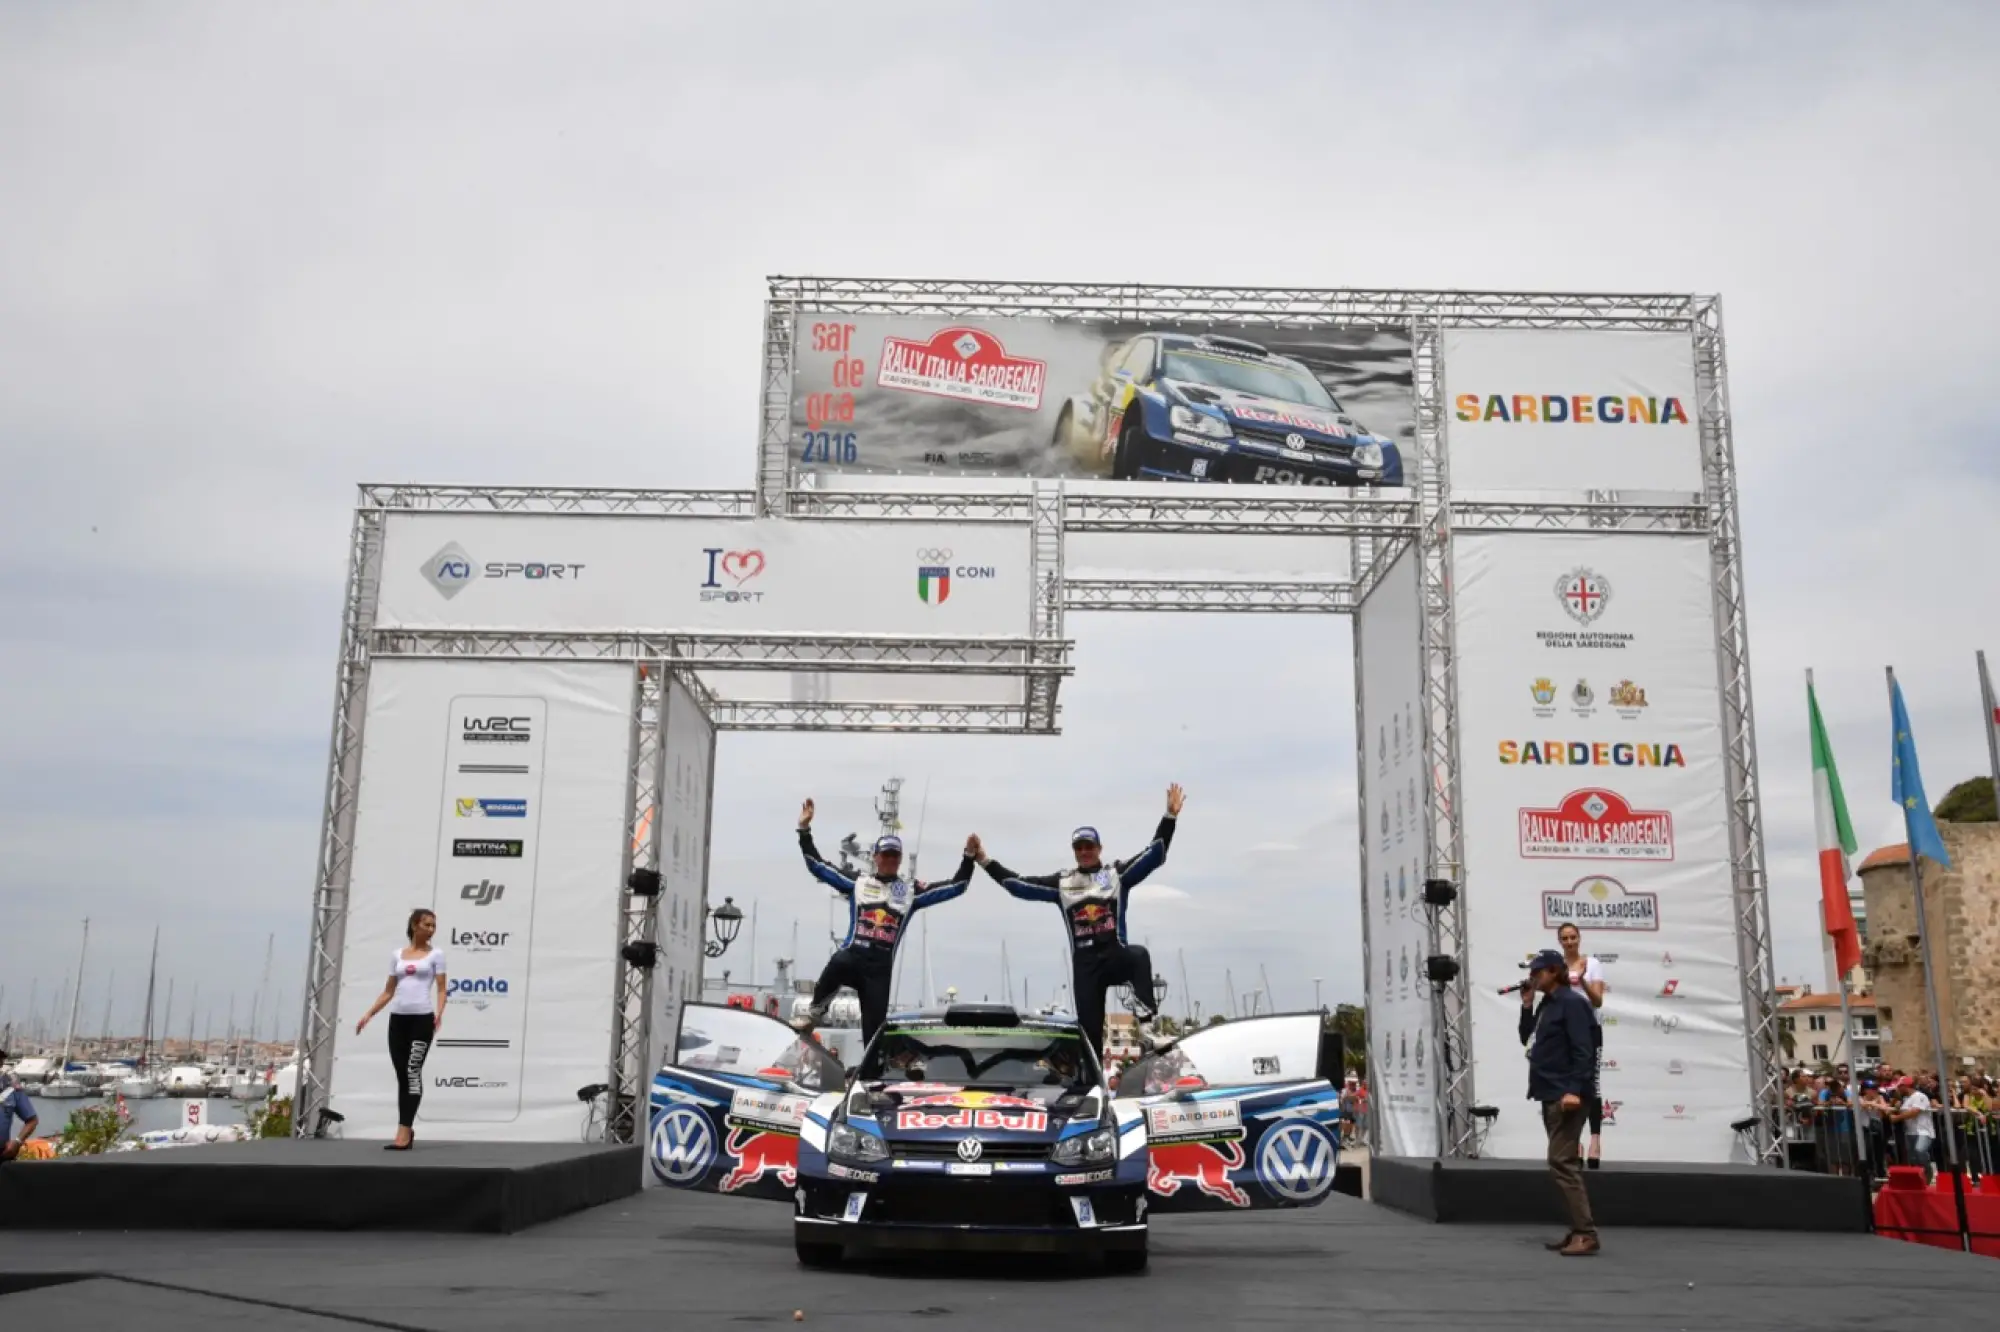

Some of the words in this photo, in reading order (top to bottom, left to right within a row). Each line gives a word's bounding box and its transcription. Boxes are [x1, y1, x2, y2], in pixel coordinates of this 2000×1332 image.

[811, 322, 856, 351] sar
[833, 351, 864, 388] de
[883, 341, 926, 375] RALLY
[925, 351, 968, 384] ITALIA
[969, 362, 1041, 393] SARDEGNA
[1455, 394, 1689, 425] SARDEGNA
[801, 431, 857, 464] 2016
[924, 452, 947, 466] FIA
[438, 563, 470, 579] ACI
[484, 563, 586, 579] SPORT
[956, 565, 996, 578] CONI
[700, 591, 765, 603] SPORT
[1535, 631, 1577, 640] REGIONE
[1579, 631, 1635, 641] AUTONOMA
[1545, 640, 1573, 648] DELLA
[1576, 640, 1626, 648] SARDEGNA
[464, 716, 531, 731] WRC
[1499, 740, 1687, 768] SARDEGNA
[1522, 813, 1559, 843] RALLY
[1561, 820, 1601, 844] ITALIA
[1602, 815, 1668, 845] SARDEGNA
[1547, 897, 1574, 917] RALLY
[1575, 902, 1604, 918] DELLA
[1606, 898, 1654, 919] SARDEGNA
[451, 927, 511, 946] Lexar
[735, 1097, 792, 1113] SARDEGNA
[897, 1109, 973, 1129] Red
[974, 1109, 1048, 1132] Bull
[1170, 1108, 1236, 1123] SARDEGNA
[847, 1168, 880, 1183] EDGE
[1087, 1169, 1114, 1182] EDGE
